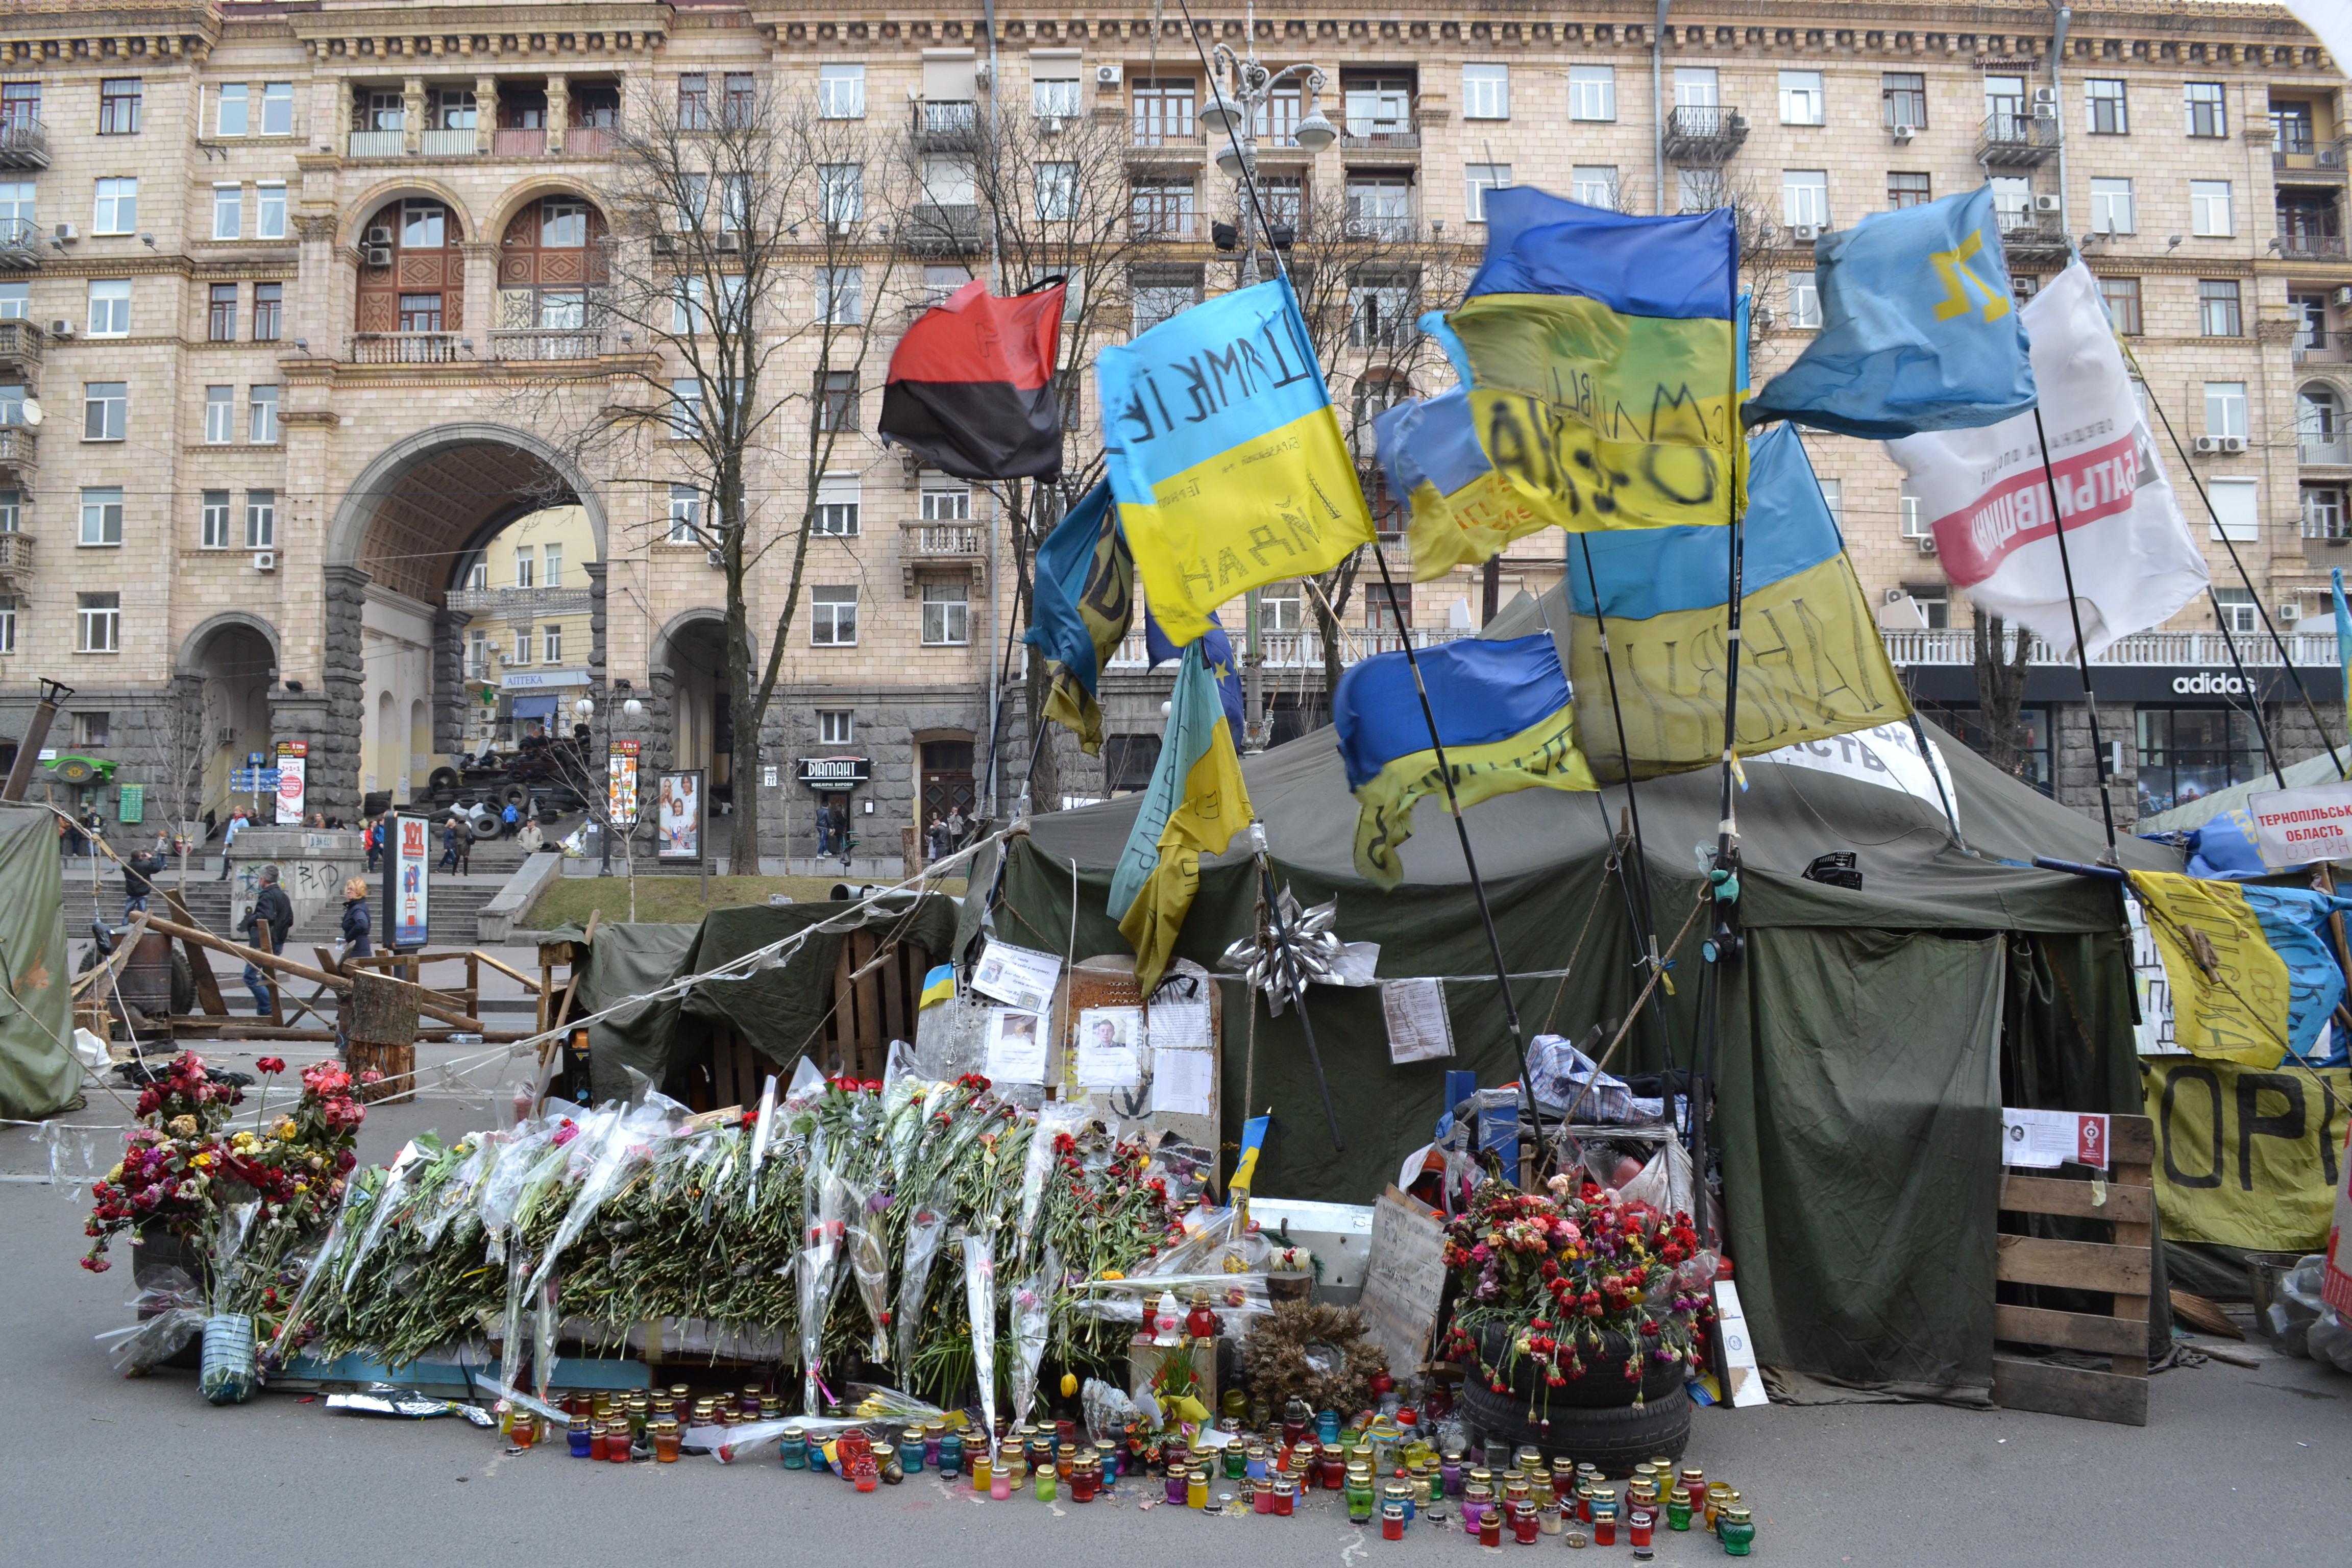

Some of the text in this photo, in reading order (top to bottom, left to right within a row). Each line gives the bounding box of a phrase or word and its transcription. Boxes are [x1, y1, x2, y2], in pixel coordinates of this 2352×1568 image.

[507, 675, 543, 685] АПТЕКА
[2172, 672, 2256, 694] adidas
[404, 822, 423, 844] 101
[2286, 825, 2344, 842] ОБЛАСТЬ
